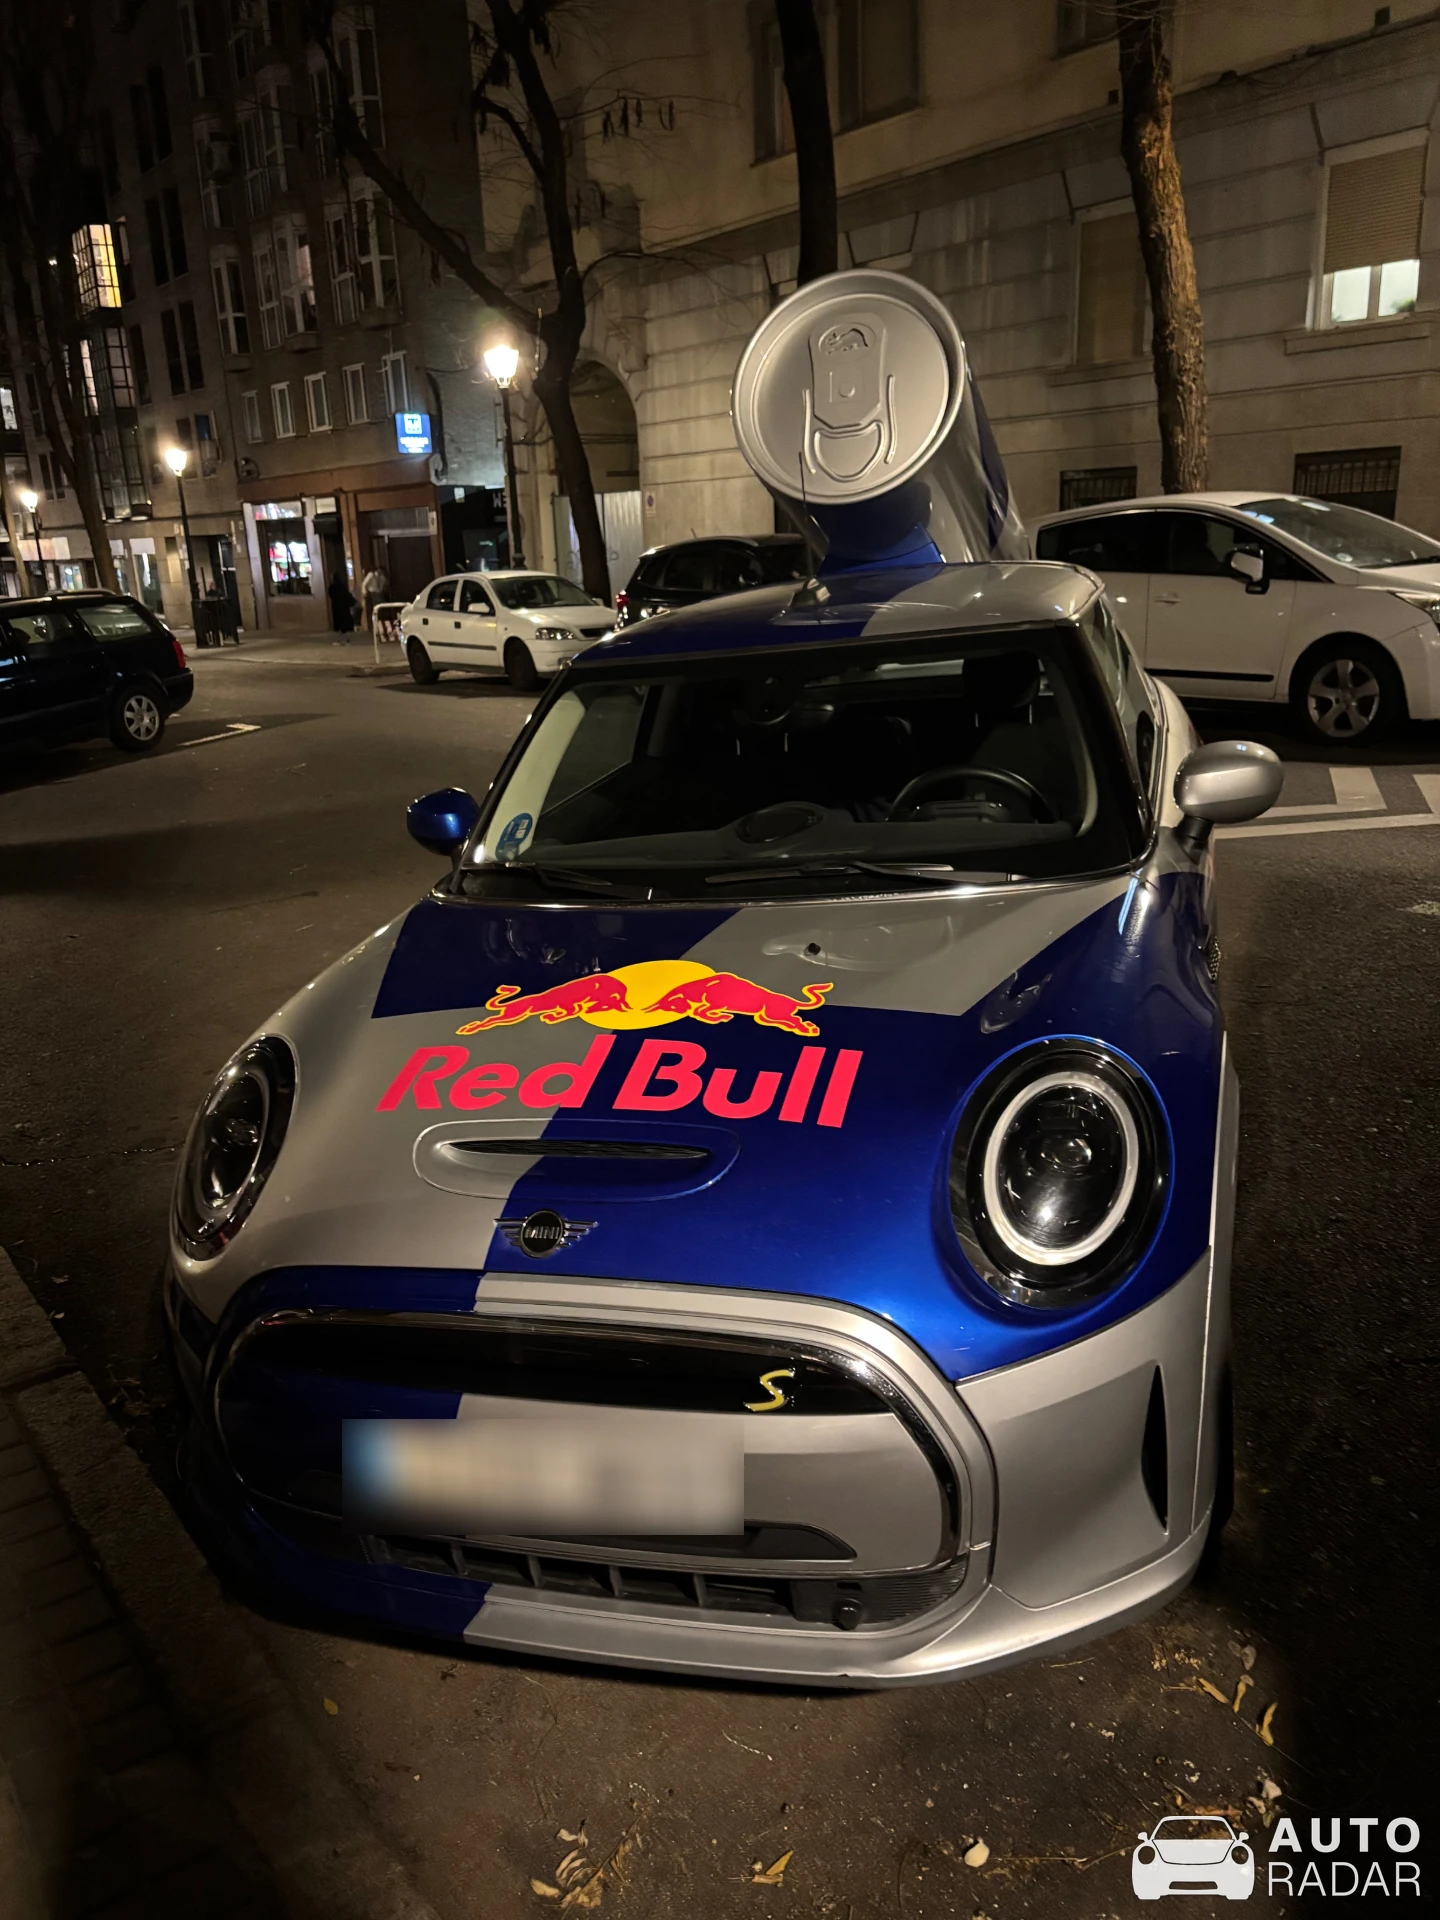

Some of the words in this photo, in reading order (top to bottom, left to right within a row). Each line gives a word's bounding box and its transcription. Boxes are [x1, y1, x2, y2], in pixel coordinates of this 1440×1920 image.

[376, 1034, 616, 1112] Red
[613, 1039, 863, 1128] Bull
[524, 1226, 560, 1240] MINI
[743, 1369, 795, 1412] S
